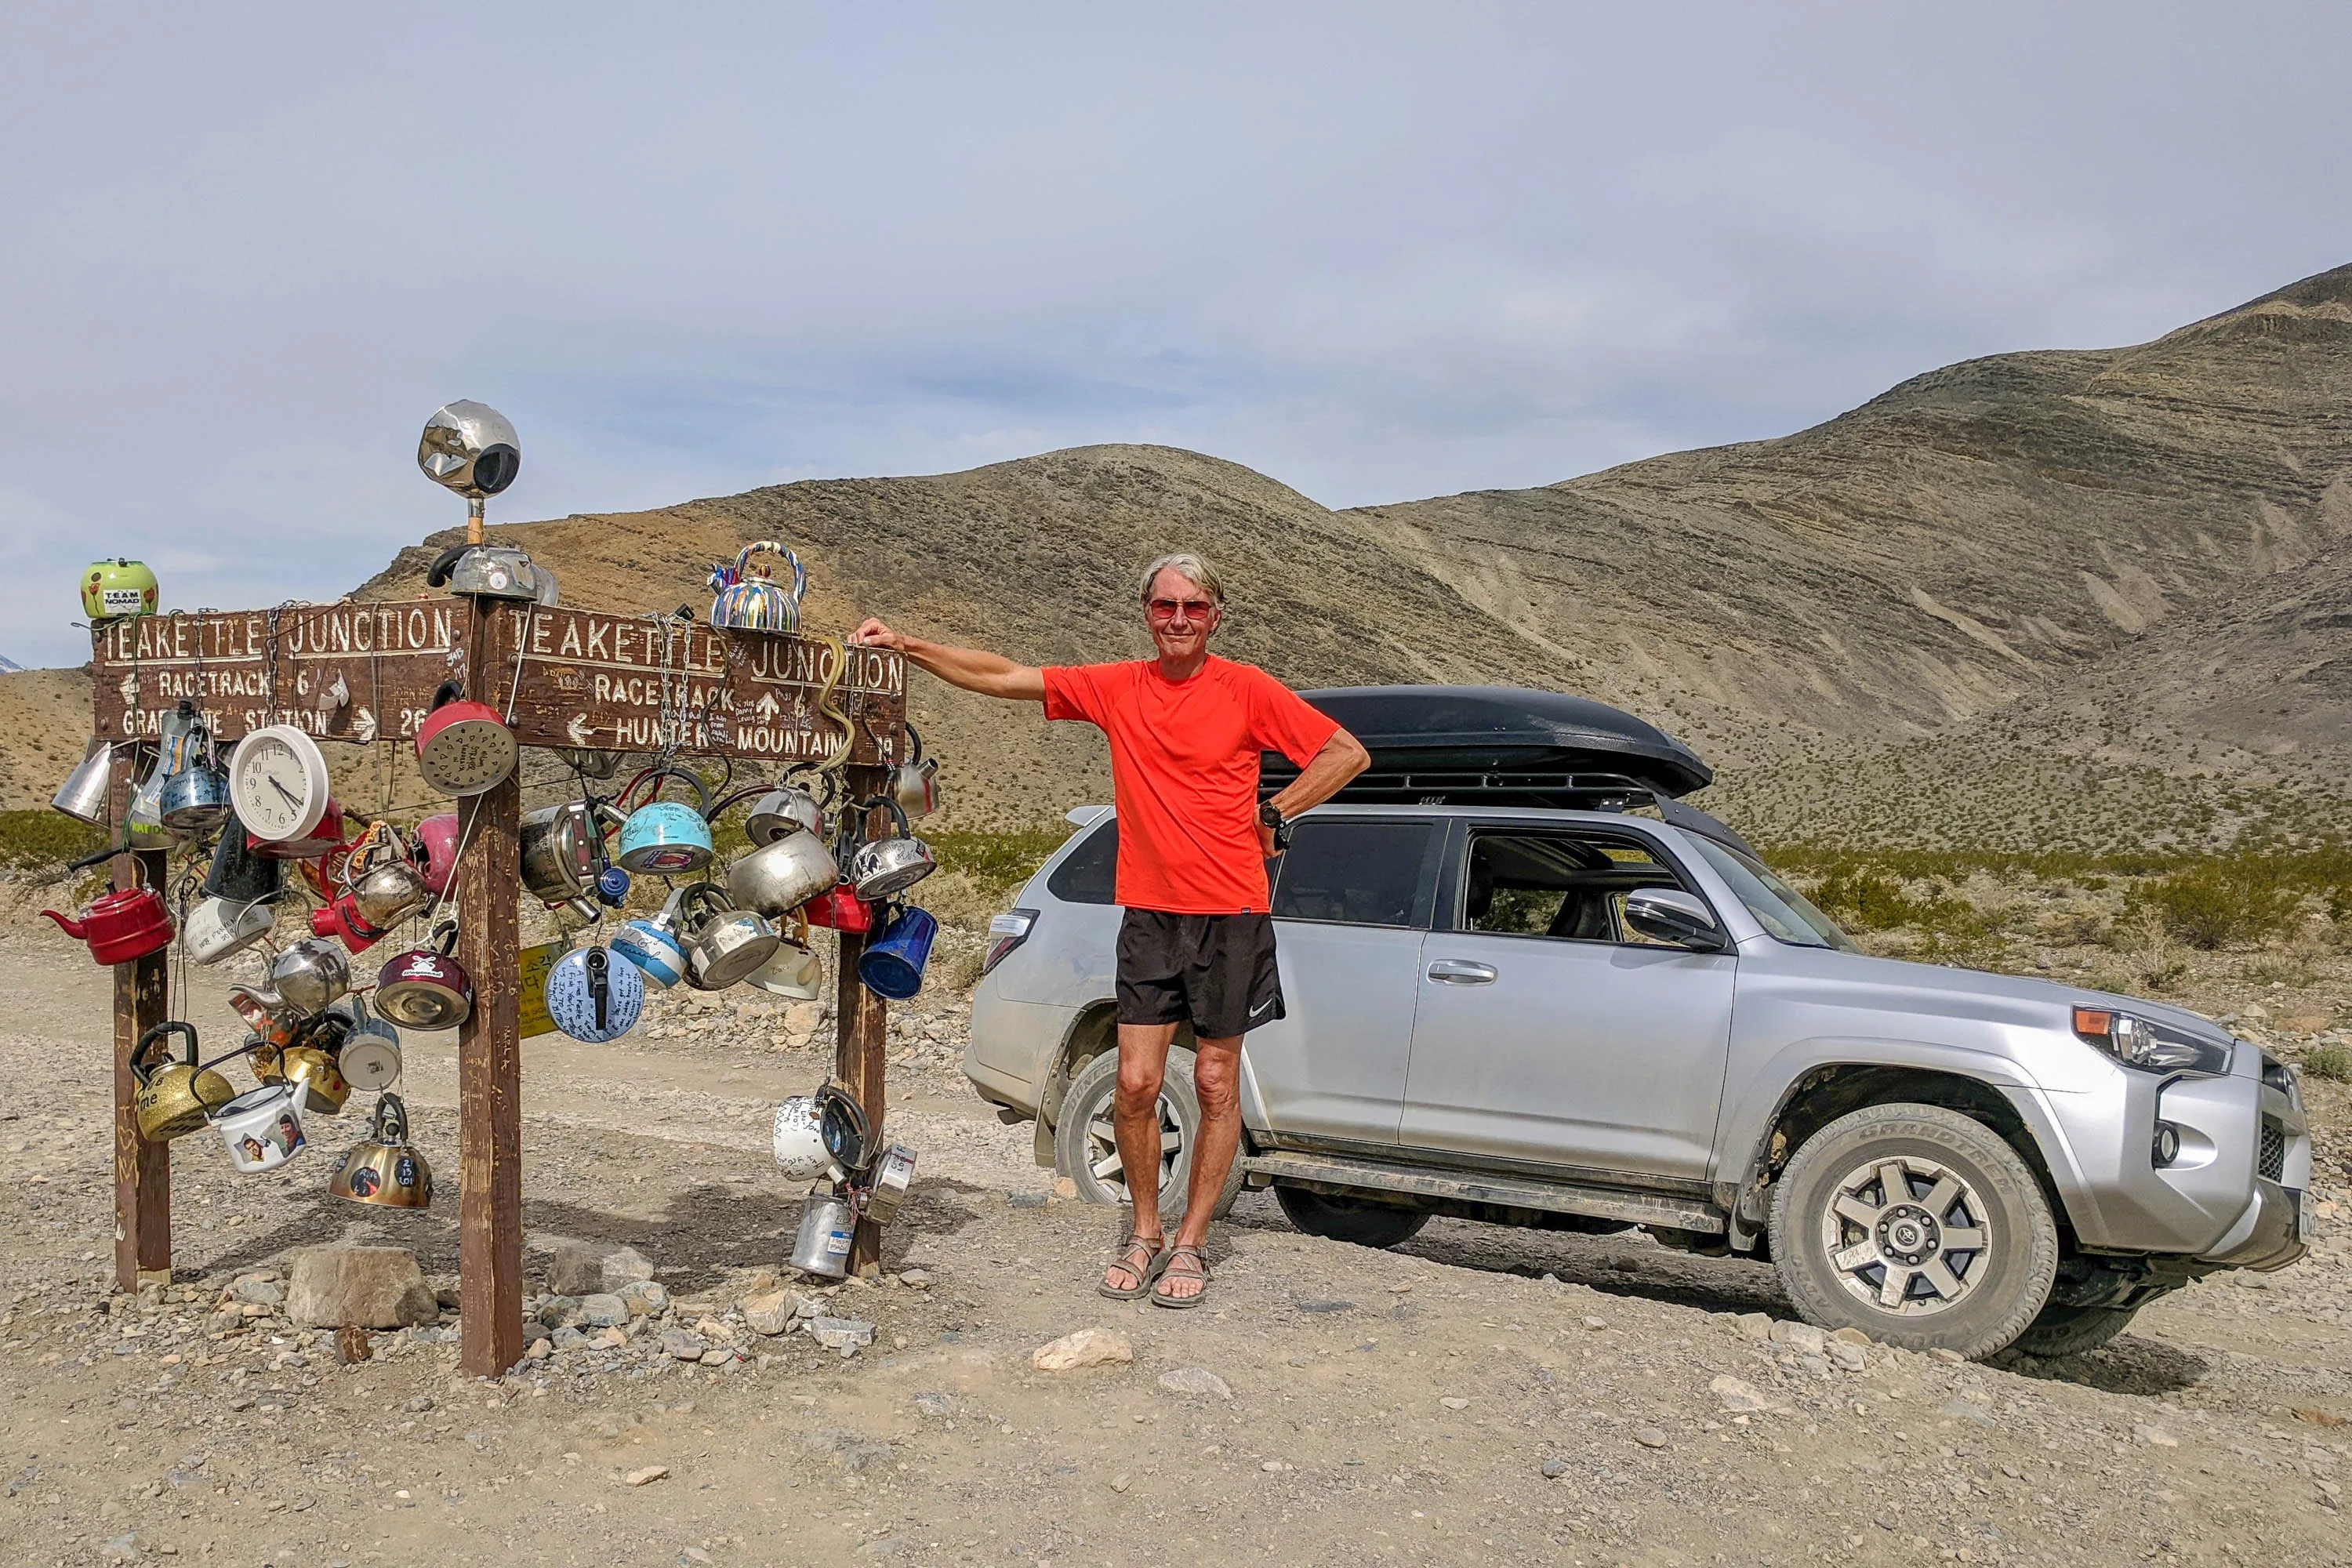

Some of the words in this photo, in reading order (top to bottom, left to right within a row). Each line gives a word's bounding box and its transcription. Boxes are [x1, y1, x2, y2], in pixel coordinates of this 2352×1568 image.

[289, 608, 452, 653] JUNCTION
[297, 669, 309, 695] 6
[793, 695, 806, 717] 6
[737, 724, 844, 757] MOUNTAIN
[261, 749, 269, 760] 11
[273, 744, 284, 756] 12
[289, 748, 293, 760] 1
[252, 761, 261, 774] 10
[250, 778, 256, 789] 9
[255, 795, 261, 807] 8
[266, 808, 272, 820] 7
[278, 812, 285, 824] 6
[291, 809, 297, 821] 5
[140, 1094, 158, 1112] me
